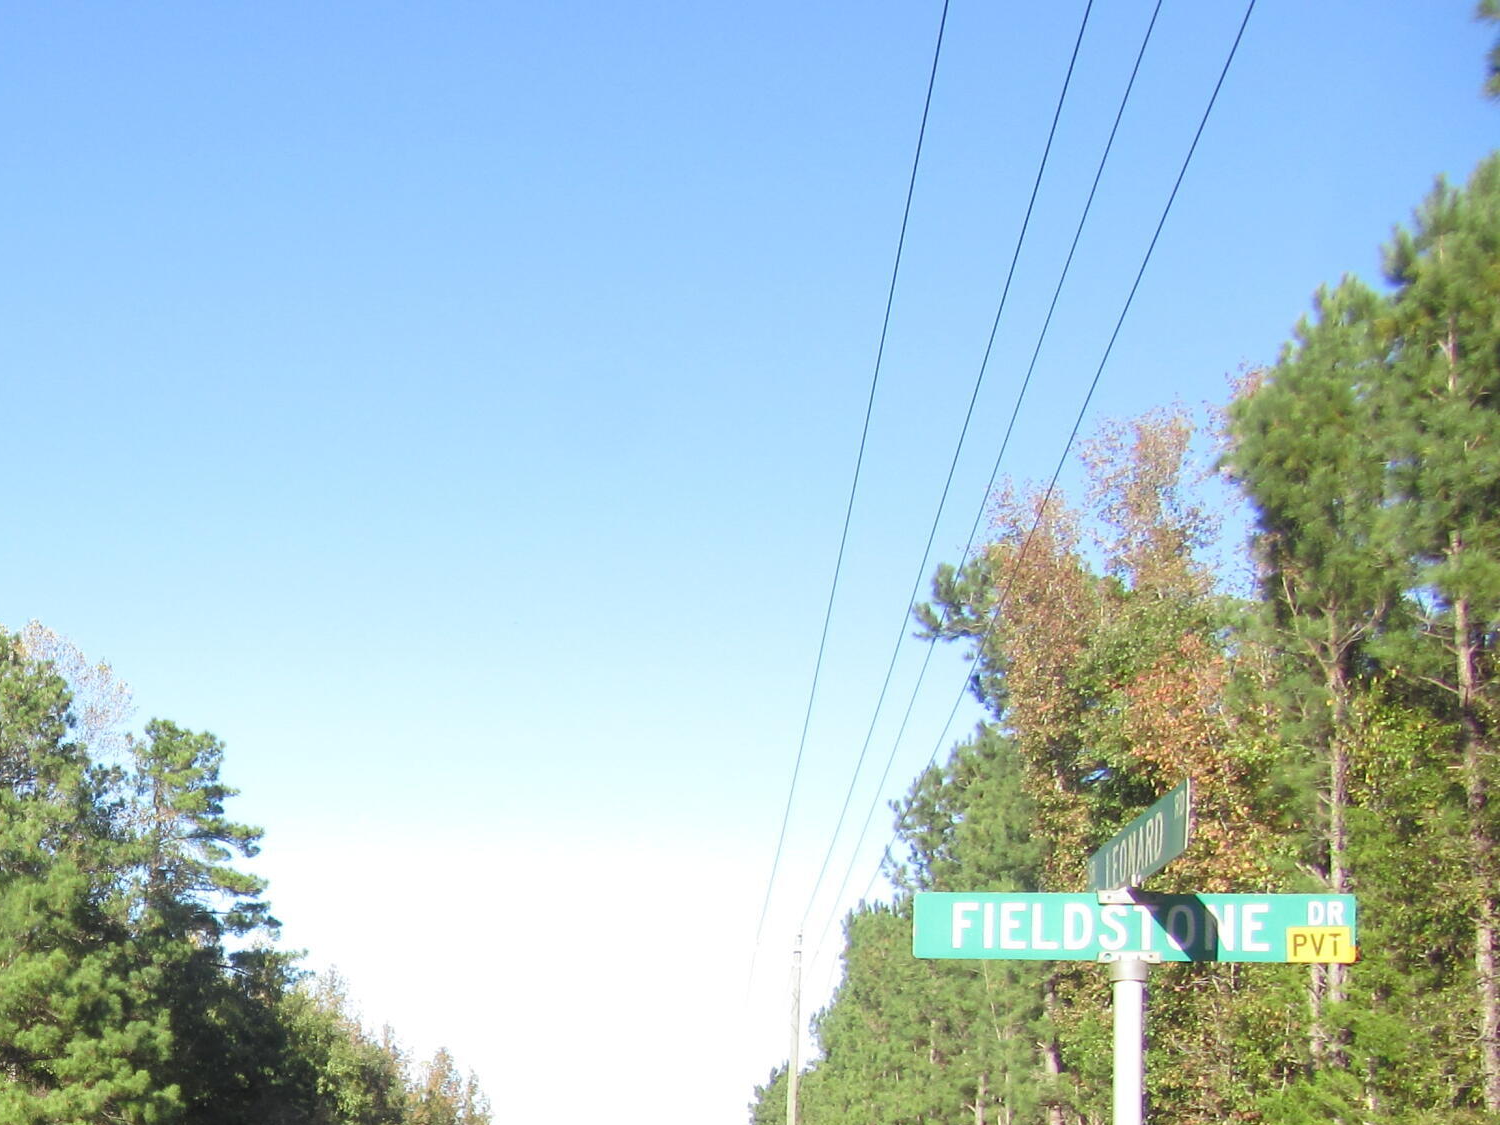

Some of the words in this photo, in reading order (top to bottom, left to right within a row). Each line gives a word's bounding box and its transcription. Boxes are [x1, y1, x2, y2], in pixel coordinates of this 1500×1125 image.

[1105, 811, 1164, 889] LEONARD
[952, 902, 1271, 952] FIELDSTONE
[1308, 901, 1344, 926] DR
[1293, 932, 1343, 957] PVT
